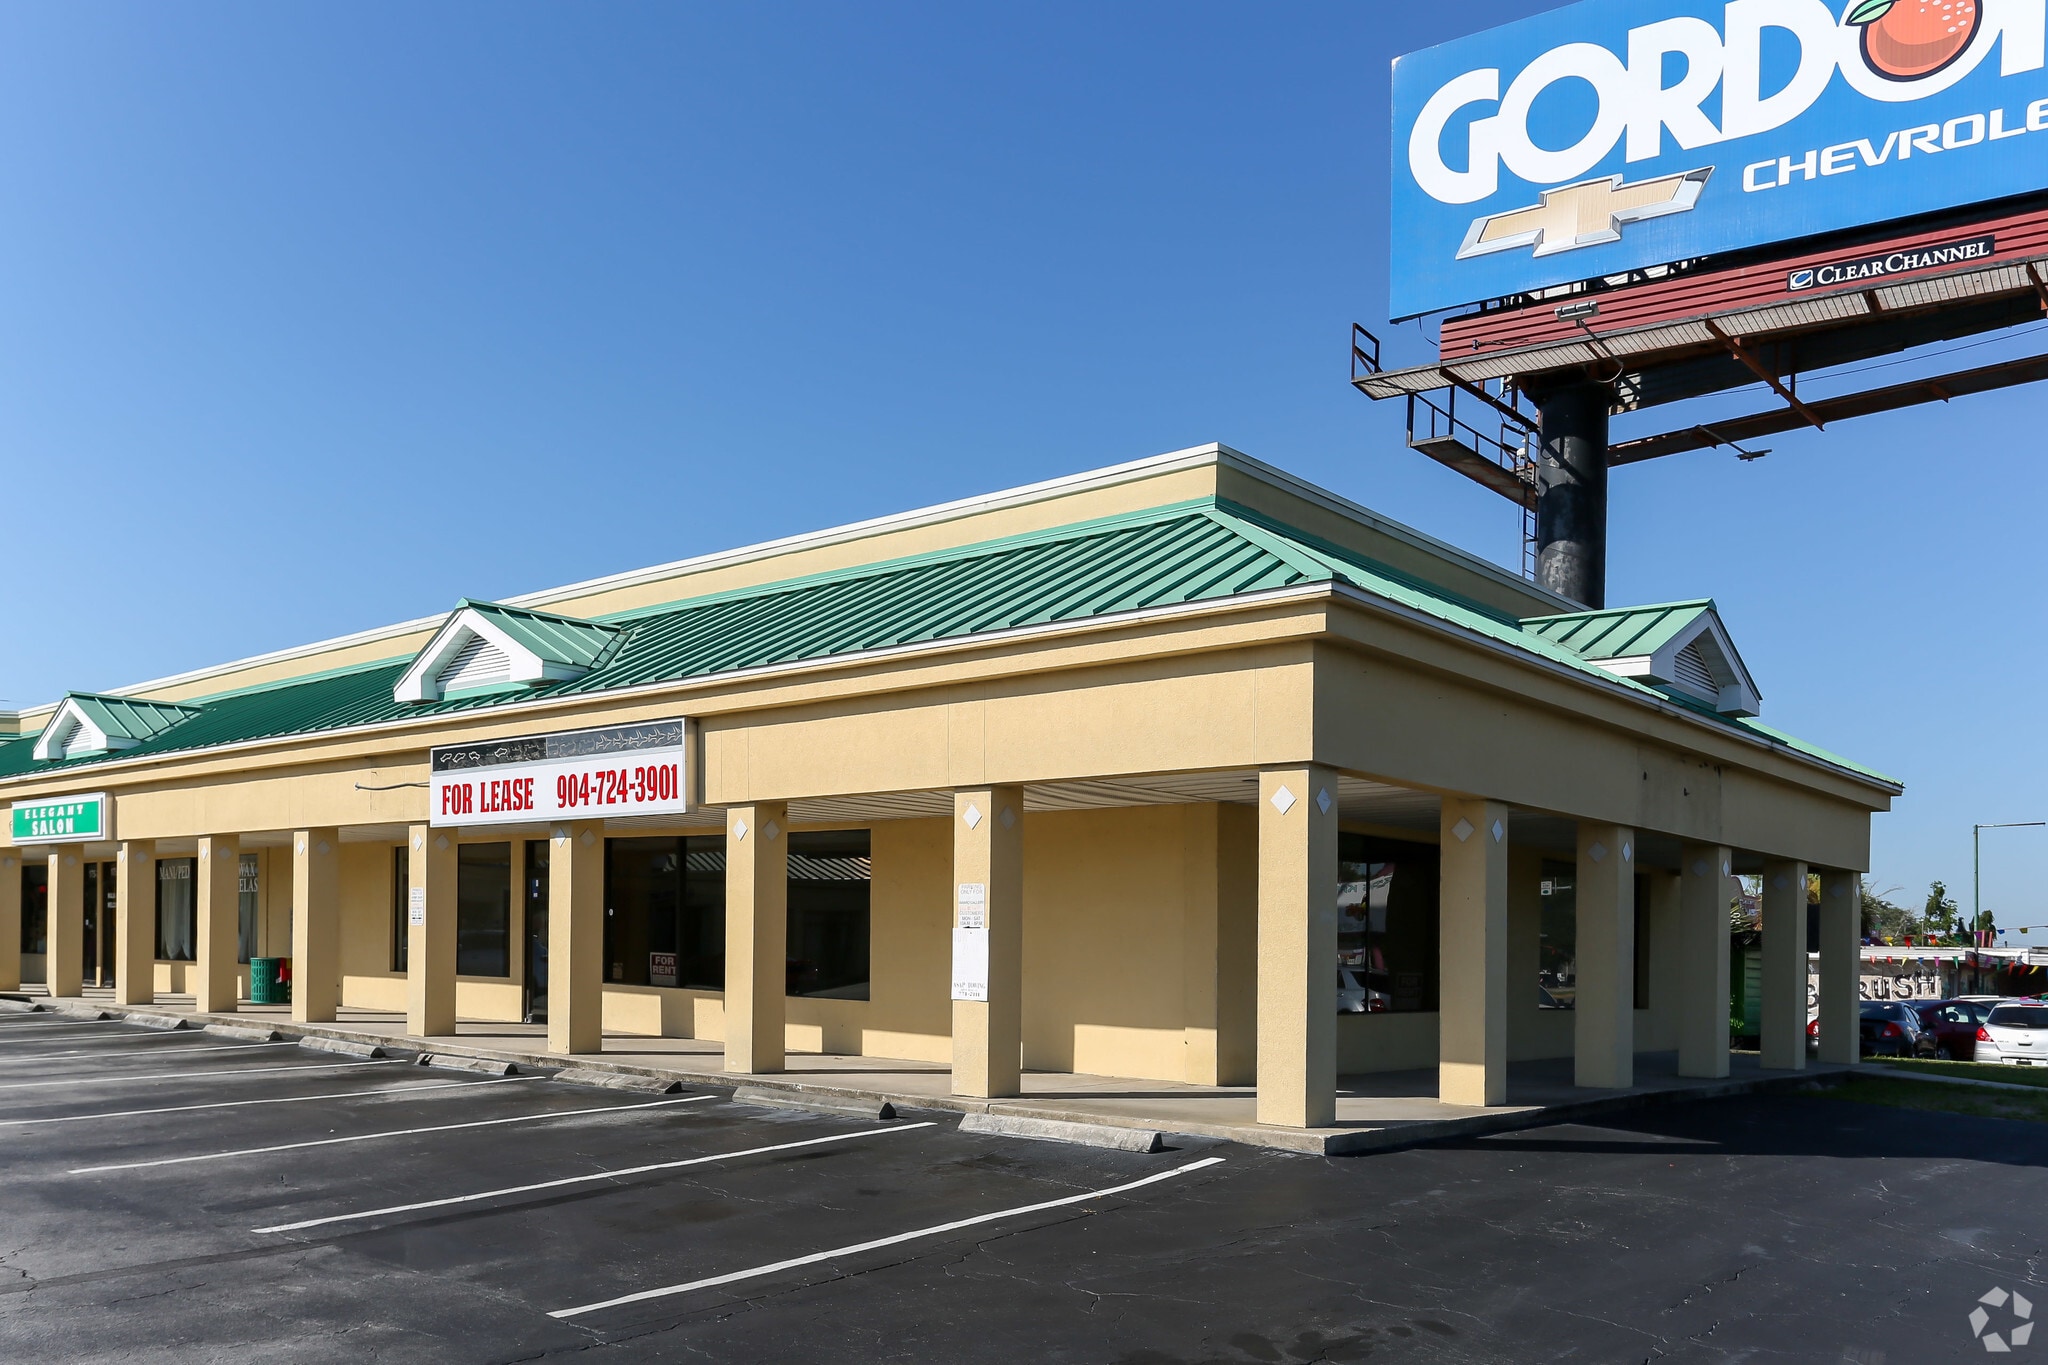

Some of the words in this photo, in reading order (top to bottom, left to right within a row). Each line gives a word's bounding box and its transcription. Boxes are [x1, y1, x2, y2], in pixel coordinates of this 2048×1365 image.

[442, 783, 473, 815] FOR
[480, 778, 534, 812] LEASE
[557, 764, 679, 809] 904-724-3901
[24, 804, 84, 819] ELEGANT
[31, 817, 74, 836] SALON
[655, 956, 675, 965] FOR
[652, 965, 677, 975] RENT
